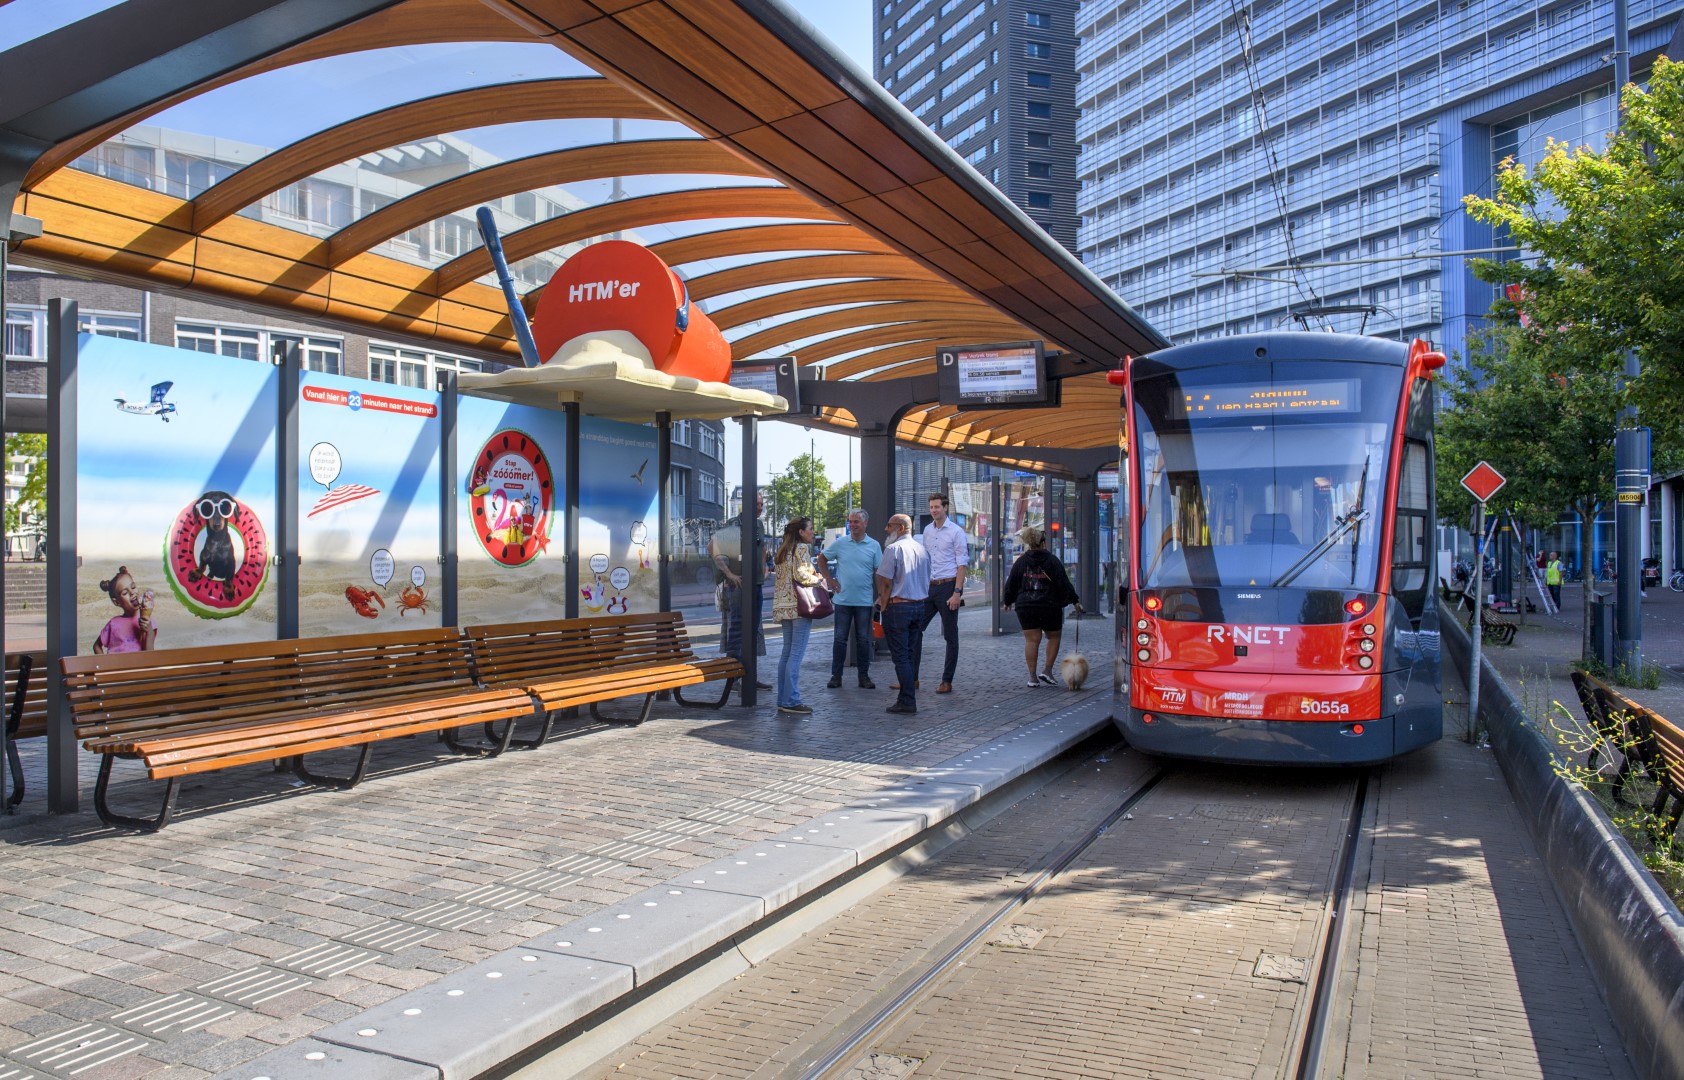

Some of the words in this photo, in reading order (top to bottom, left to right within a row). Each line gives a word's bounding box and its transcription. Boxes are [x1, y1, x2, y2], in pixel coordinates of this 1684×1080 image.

[569, 280, 640, 303] HTM'er
[943, 353, 954, 366] D
[779, 364, 788, 376] C
[306, 389, 325, 400] Vanaf
[326, 392, 339, 401] hier
[349, 395, 361, 406] 23
[364, 398, 388, 408] minuten
[389, 402, 402, 410] naar
[404, 403, 413, 412] het
[414, 406, 434, 415] strand!
[493, 468, 534, 480] zóóómer!
[1162, 691, 1186, 702] HTM
[1224, 692, 1248, 700] MRDH
[1300, 701, 1349, 714] 5055a
